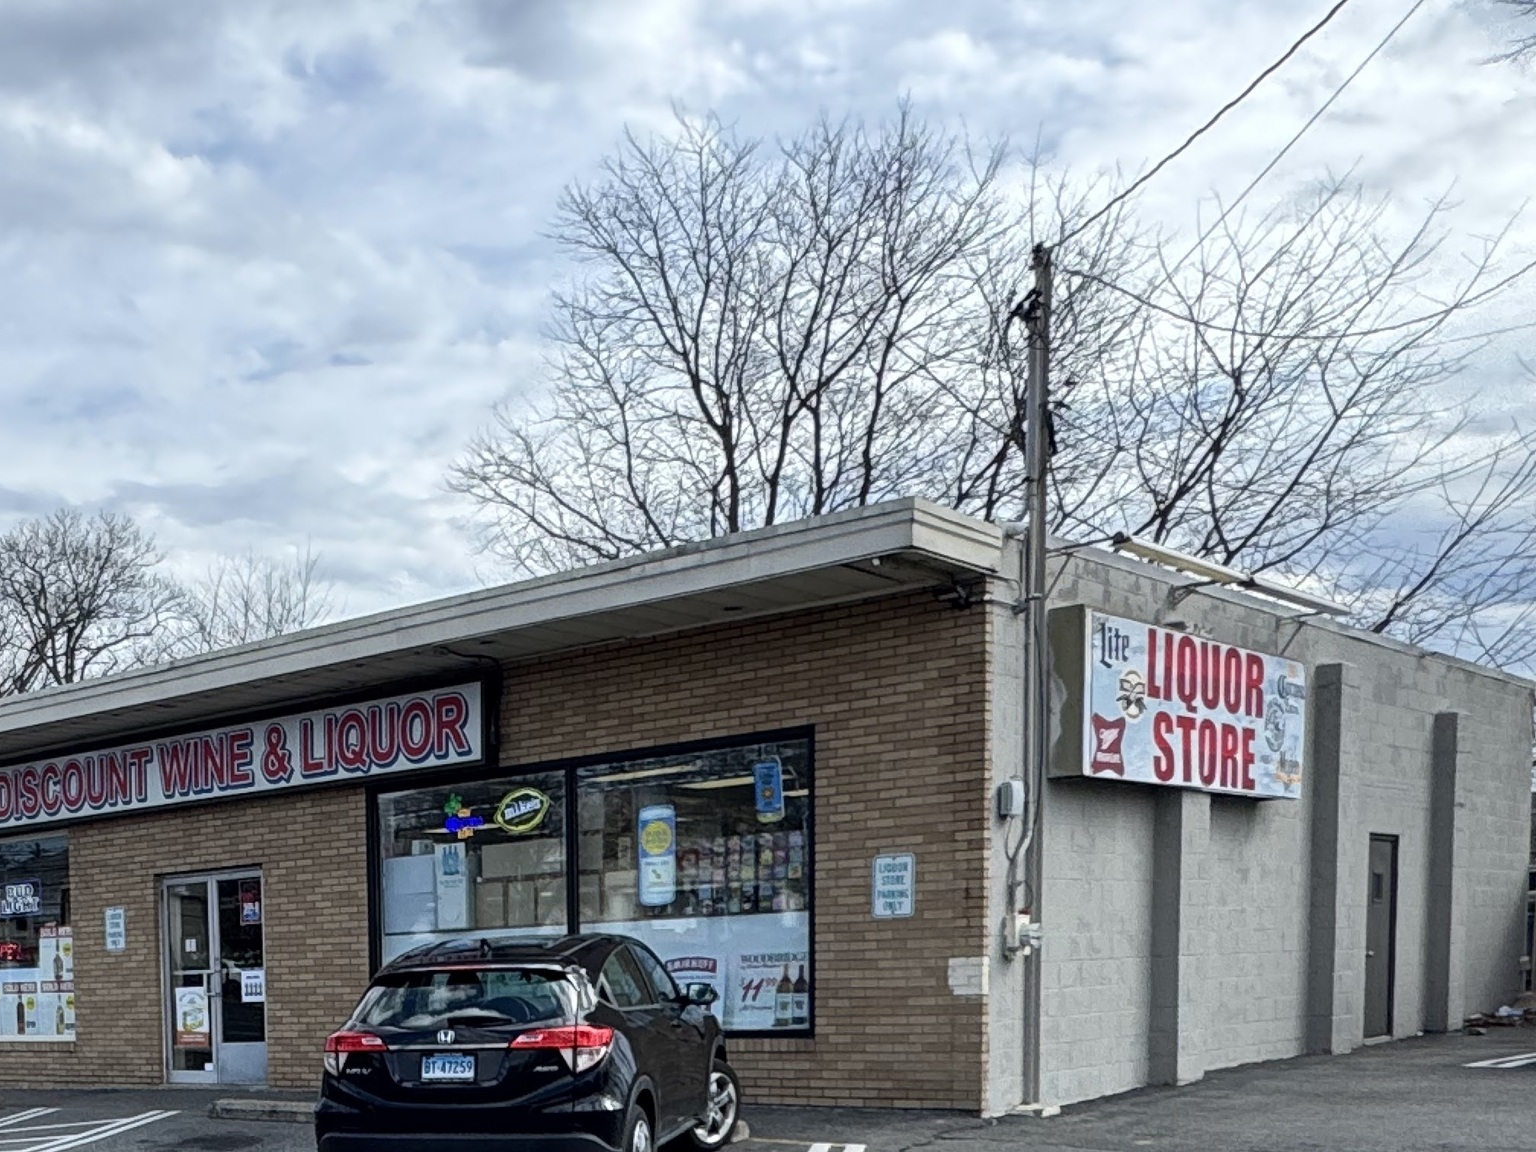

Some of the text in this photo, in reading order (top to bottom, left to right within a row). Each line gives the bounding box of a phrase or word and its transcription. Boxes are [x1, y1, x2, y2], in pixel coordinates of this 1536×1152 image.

[1099, 622, 1130, 668] Lite
[1146, 628, 1264, 718] LIQUOR
[158, 728, 254, 798] WINE
[261, 723, 293, 783] &
[300, 693, 472, 780] LIQUOR
[1153, 711, 1256, 790] STORE
[878, 862, 908, 873] LIQUOR
[881, 875, 906, 886] STORE
[5, 884, 34, 900] BUD
[877, 889, 909, 899] PARKING
[883, 900, 904, 911] ONLY
